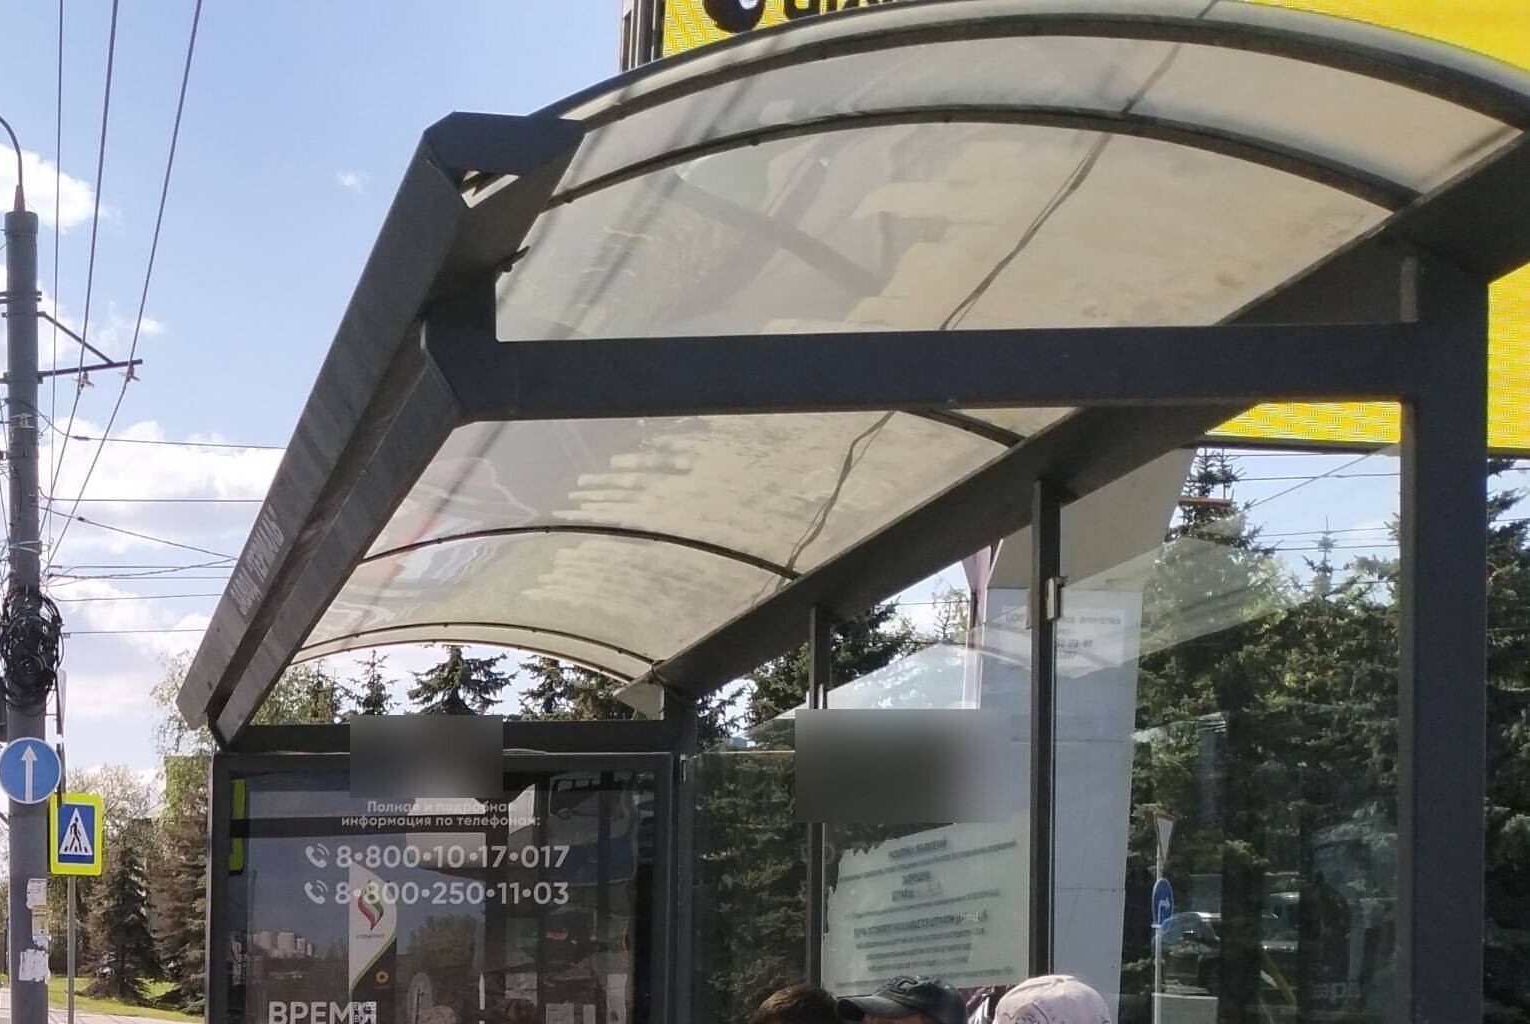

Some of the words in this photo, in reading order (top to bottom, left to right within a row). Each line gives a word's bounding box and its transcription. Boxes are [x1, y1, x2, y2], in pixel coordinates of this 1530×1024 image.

[341, 815, 432, 828] информация
[435, 817, 452, 827] по
[456, 815, 541, 827] телефонам:
